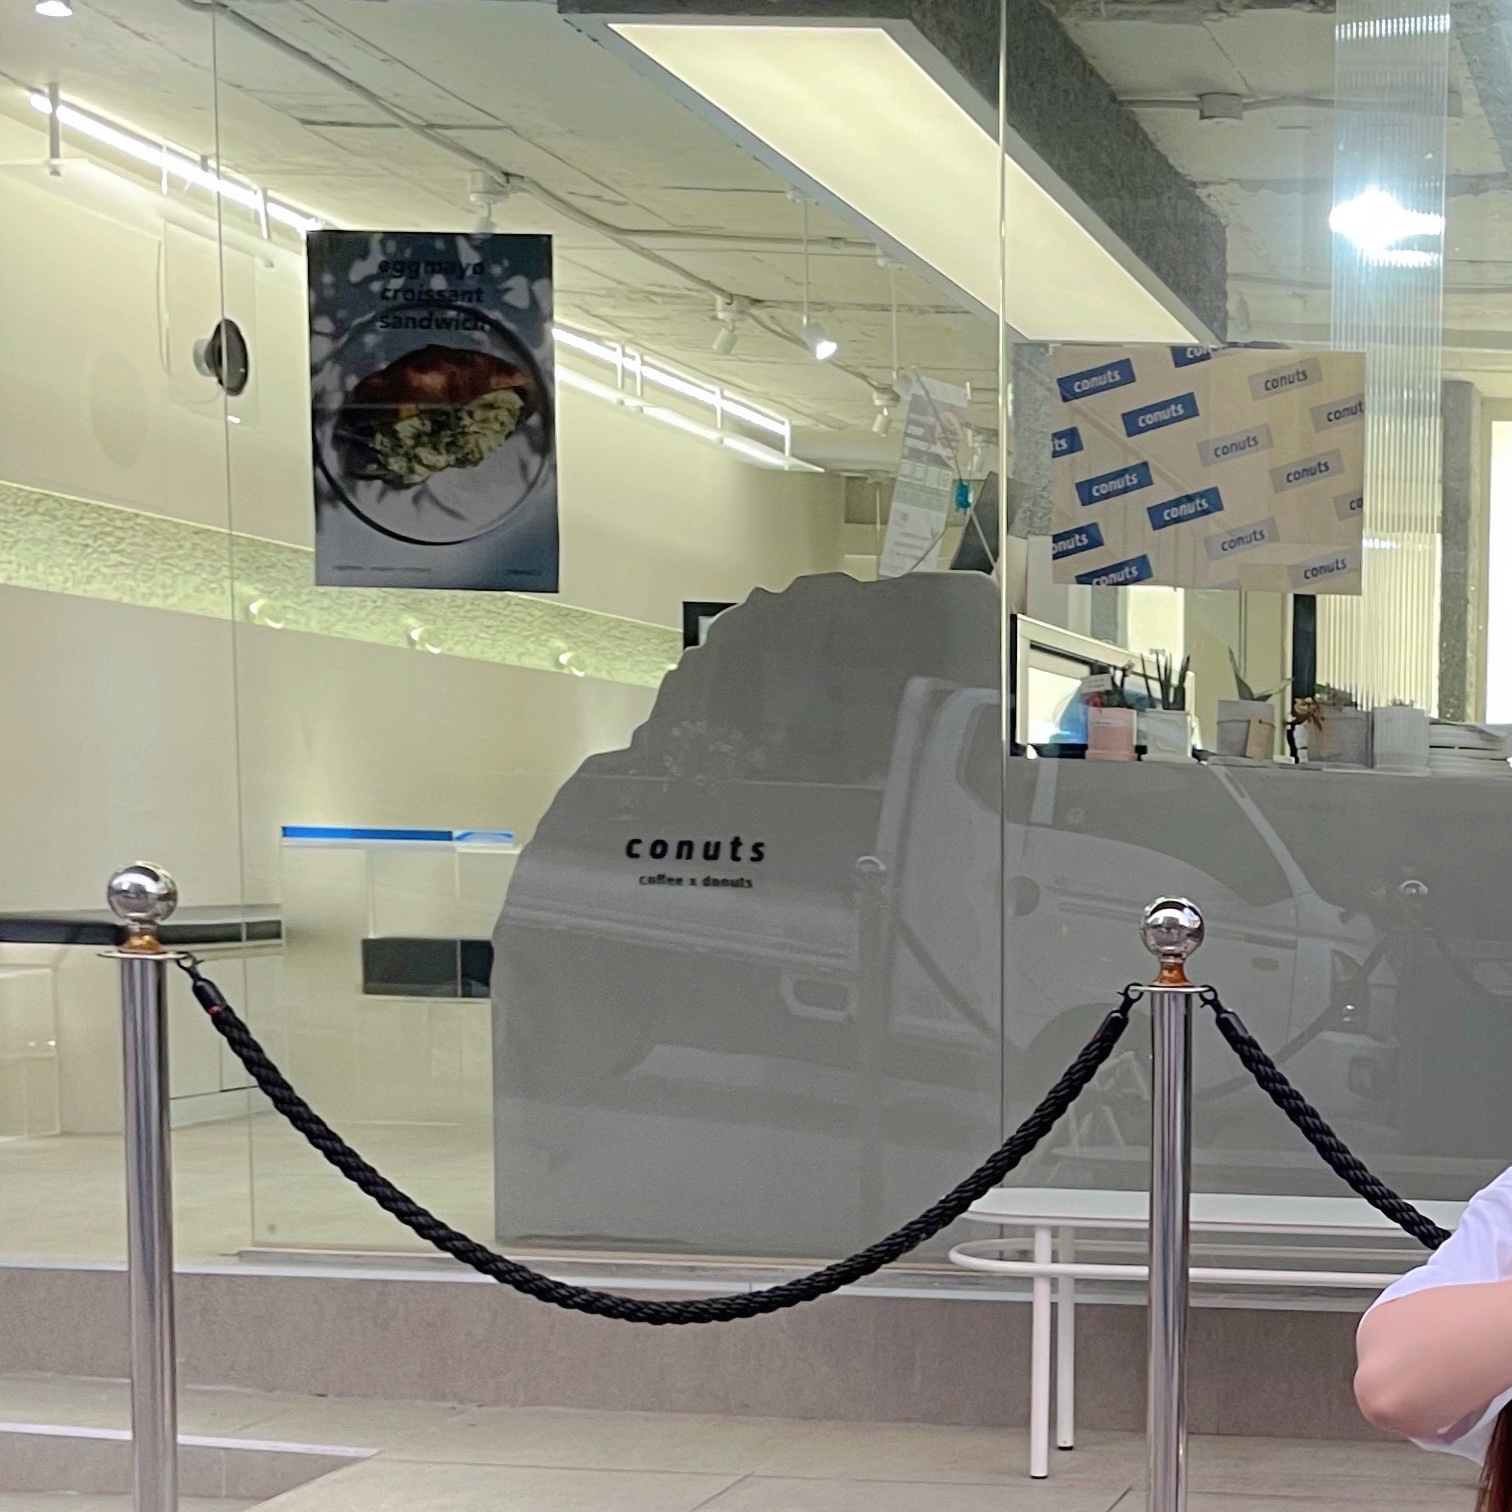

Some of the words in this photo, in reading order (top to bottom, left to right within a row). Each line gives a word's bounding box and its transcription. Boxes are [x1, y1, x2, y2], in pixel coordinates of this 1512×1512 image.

[380, 284, 484, 303] croissant
[1073, 369, 1121, 393] conuts
[1264, 369, 1308, 391] conuts
[1137, 403, 1185, 428] conuts
[1214, 435, 1259, 458] conuts
[1286, 461, 1330, 483] conuts
[1091, 472, 1139, 497] conuts
[1163, 498, 1209, 521] conuts
[1221, 529, 1265, 551] conuts
[1092, 565, 1139, 586] conuts
[1303, 558, 1347, 580] conuts
[625, 836, 766, 862] conuts
[639, 874, 684, 887] coffee
[689, 877, 697, 887] x
[702, 875, 753, 888] donuts
